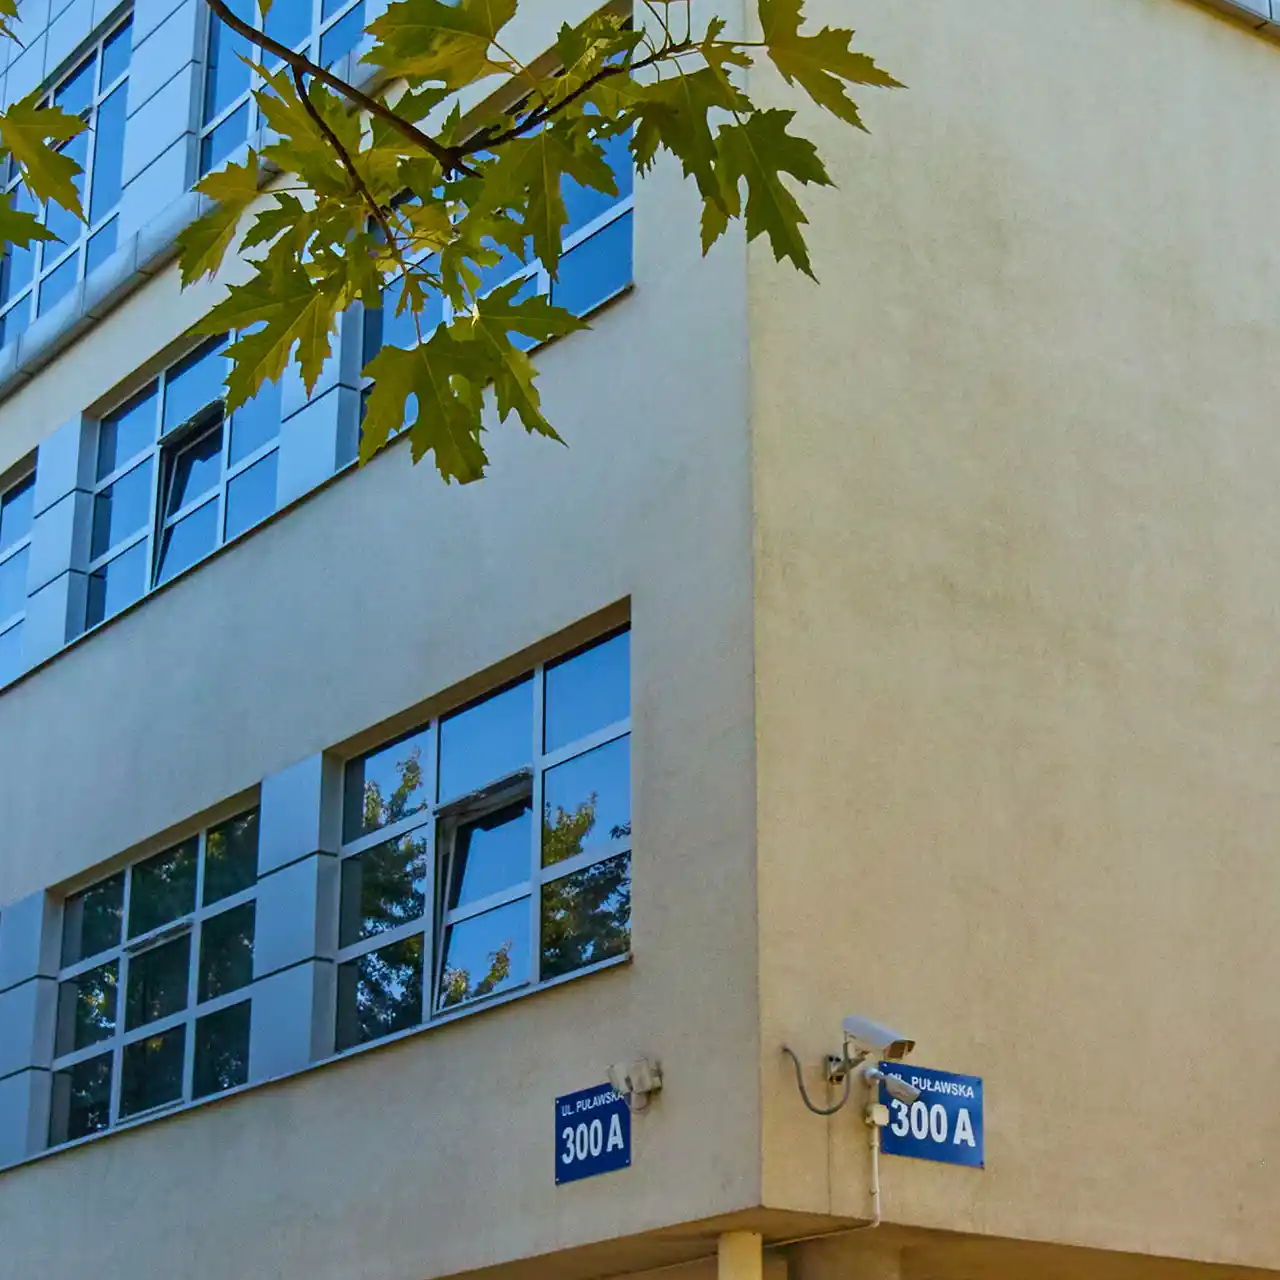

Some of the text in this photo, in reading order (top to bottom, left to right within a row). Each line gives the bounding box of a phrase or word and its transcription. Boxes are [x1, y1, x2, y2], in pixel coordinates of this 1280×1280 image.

[910, 1075, 975, 1099] PUŁAWSKA
[561, 1113, 625, 1165] 300 A
[890, 1098, 977, 1148] 300 A
